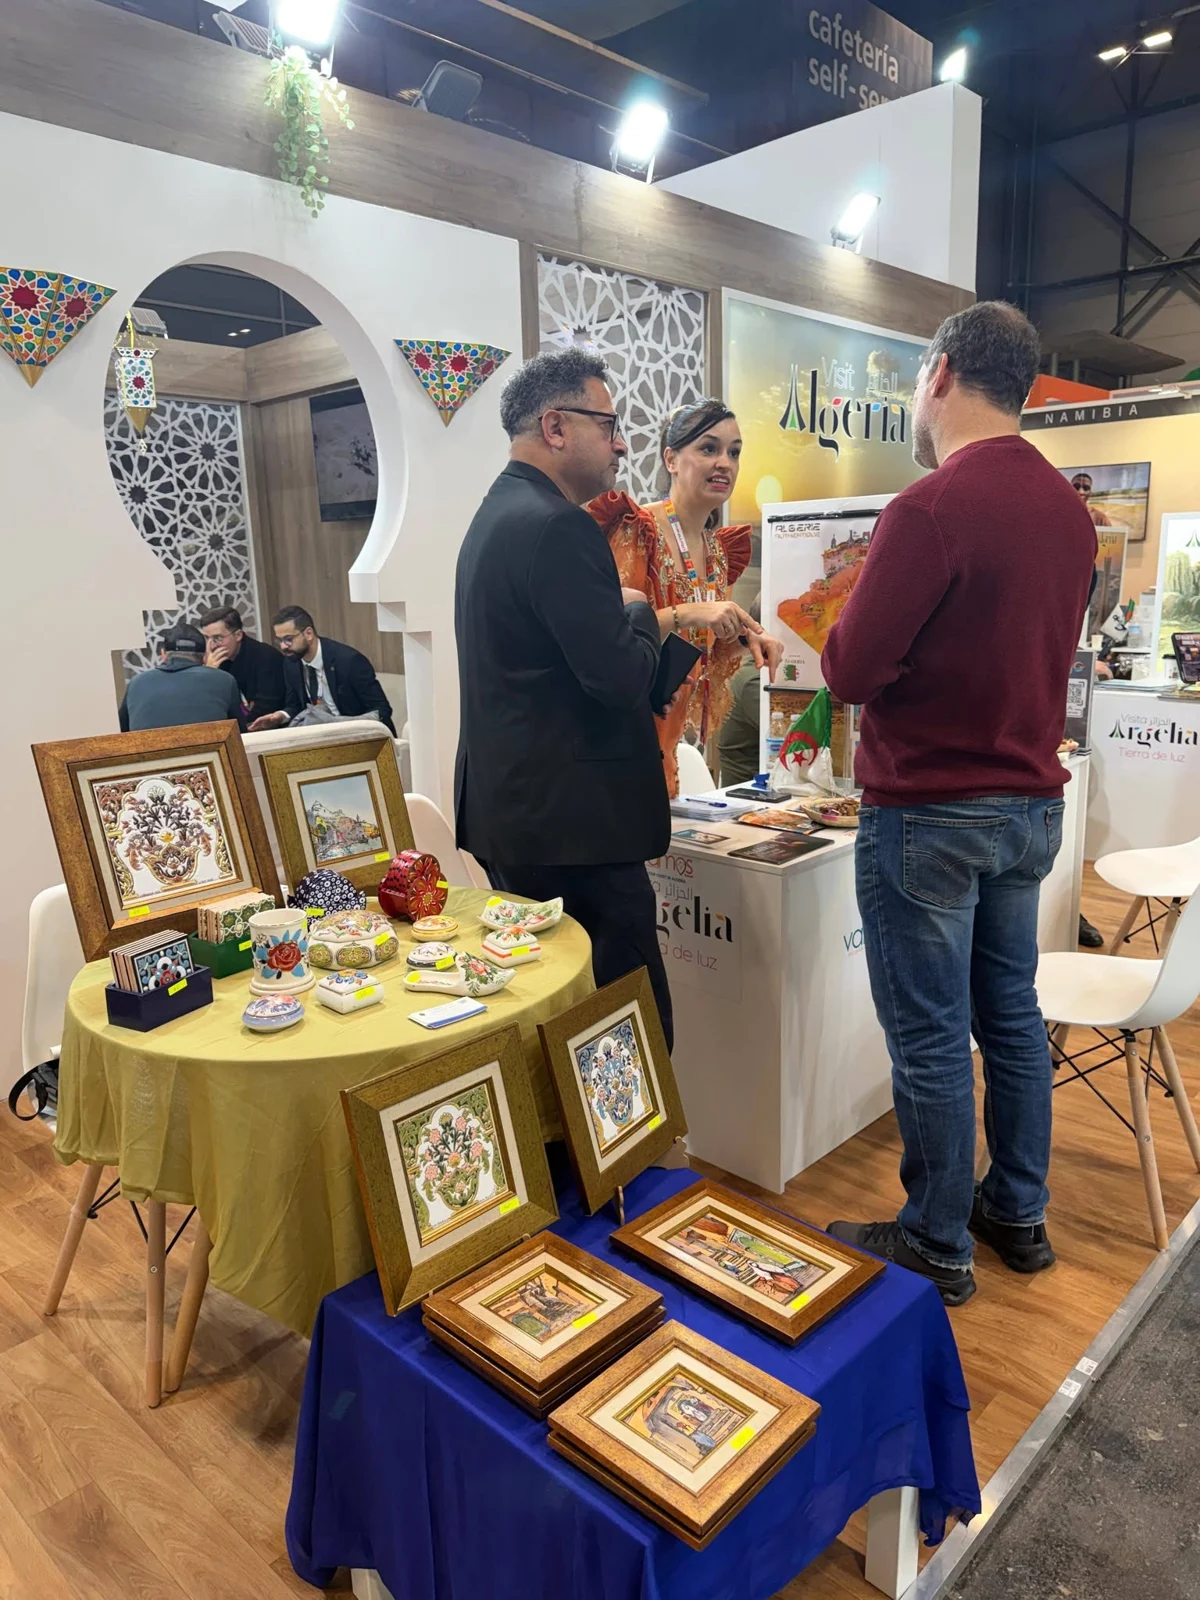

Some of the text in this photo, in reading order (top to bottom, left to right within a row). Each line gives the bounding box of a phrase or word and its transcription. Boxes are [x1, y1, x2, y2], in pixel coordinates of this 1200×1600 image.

[808, 10, 899, 84] cafetería
[821, 356, 855, 391] Visit
[779, 363, 906, 463] Algeria
[1044, 404, 1138, 424] NAMIBIA
[1121, 713, 1147, 725] Visita
[1109, 719, 1198, 748] Argelia
[1119, 746, 1186, 763] Tierra de luz
[648, 854, 694, 876] amos
[656, 895, 733, 943] gelia
[672, 944, 693, 963] de
[697, 949, 718, 971] luz
